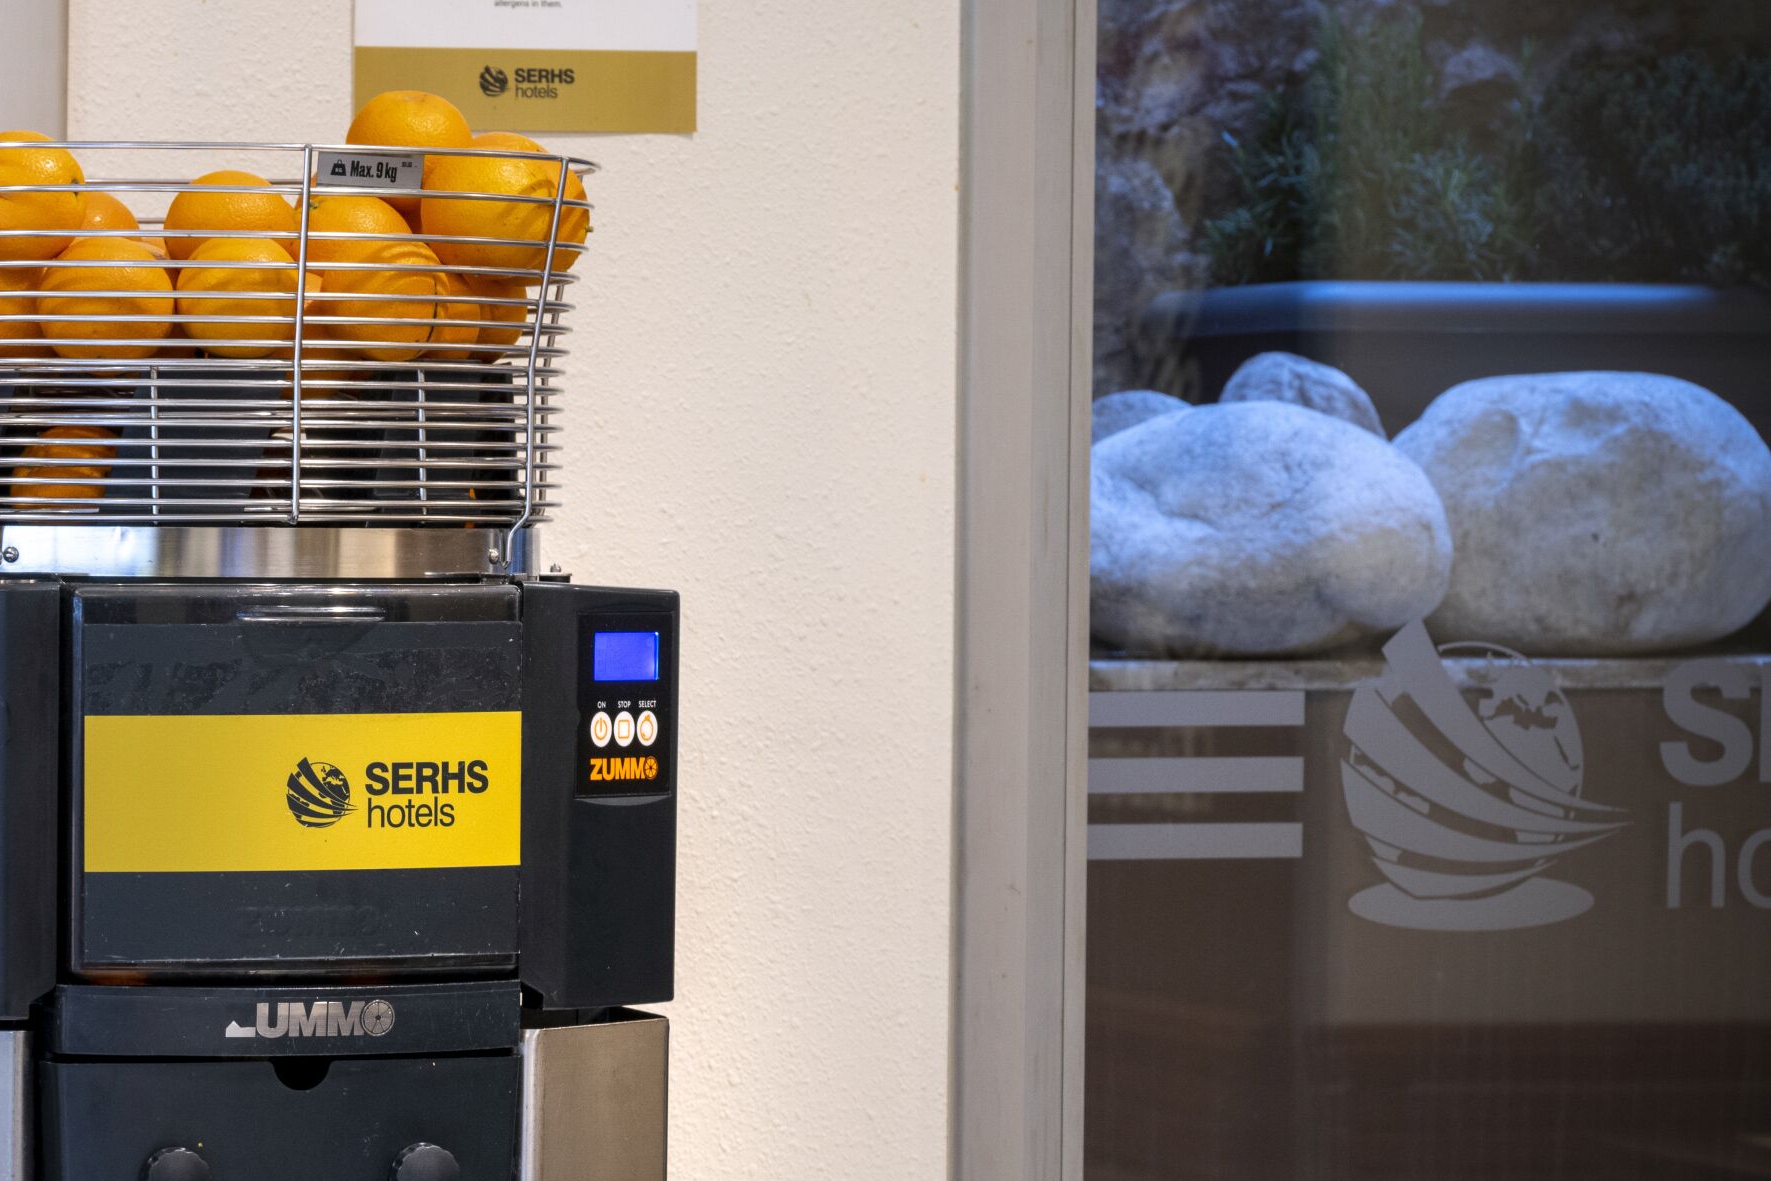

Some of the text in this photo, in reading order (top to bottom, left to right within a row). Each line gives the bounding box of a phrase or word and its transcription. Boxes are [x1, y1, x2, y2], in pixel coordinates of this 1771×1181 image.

[514, 67, 575, 84] SERHS
[515, 84, 558, 99] hotels
[350, 160, 374, 178] Max.
[376, 162, 384, 178] 9
[385, 163, 398, 182] kg
[597, 700, 657, 709] ON STOP SELECT
[1659, 658, 1771, 787] S
[364, 759, 490, 796] SERHS
[590, 756, 658, 781] ZUMMO
[366, 796, 456, 829] hotels
